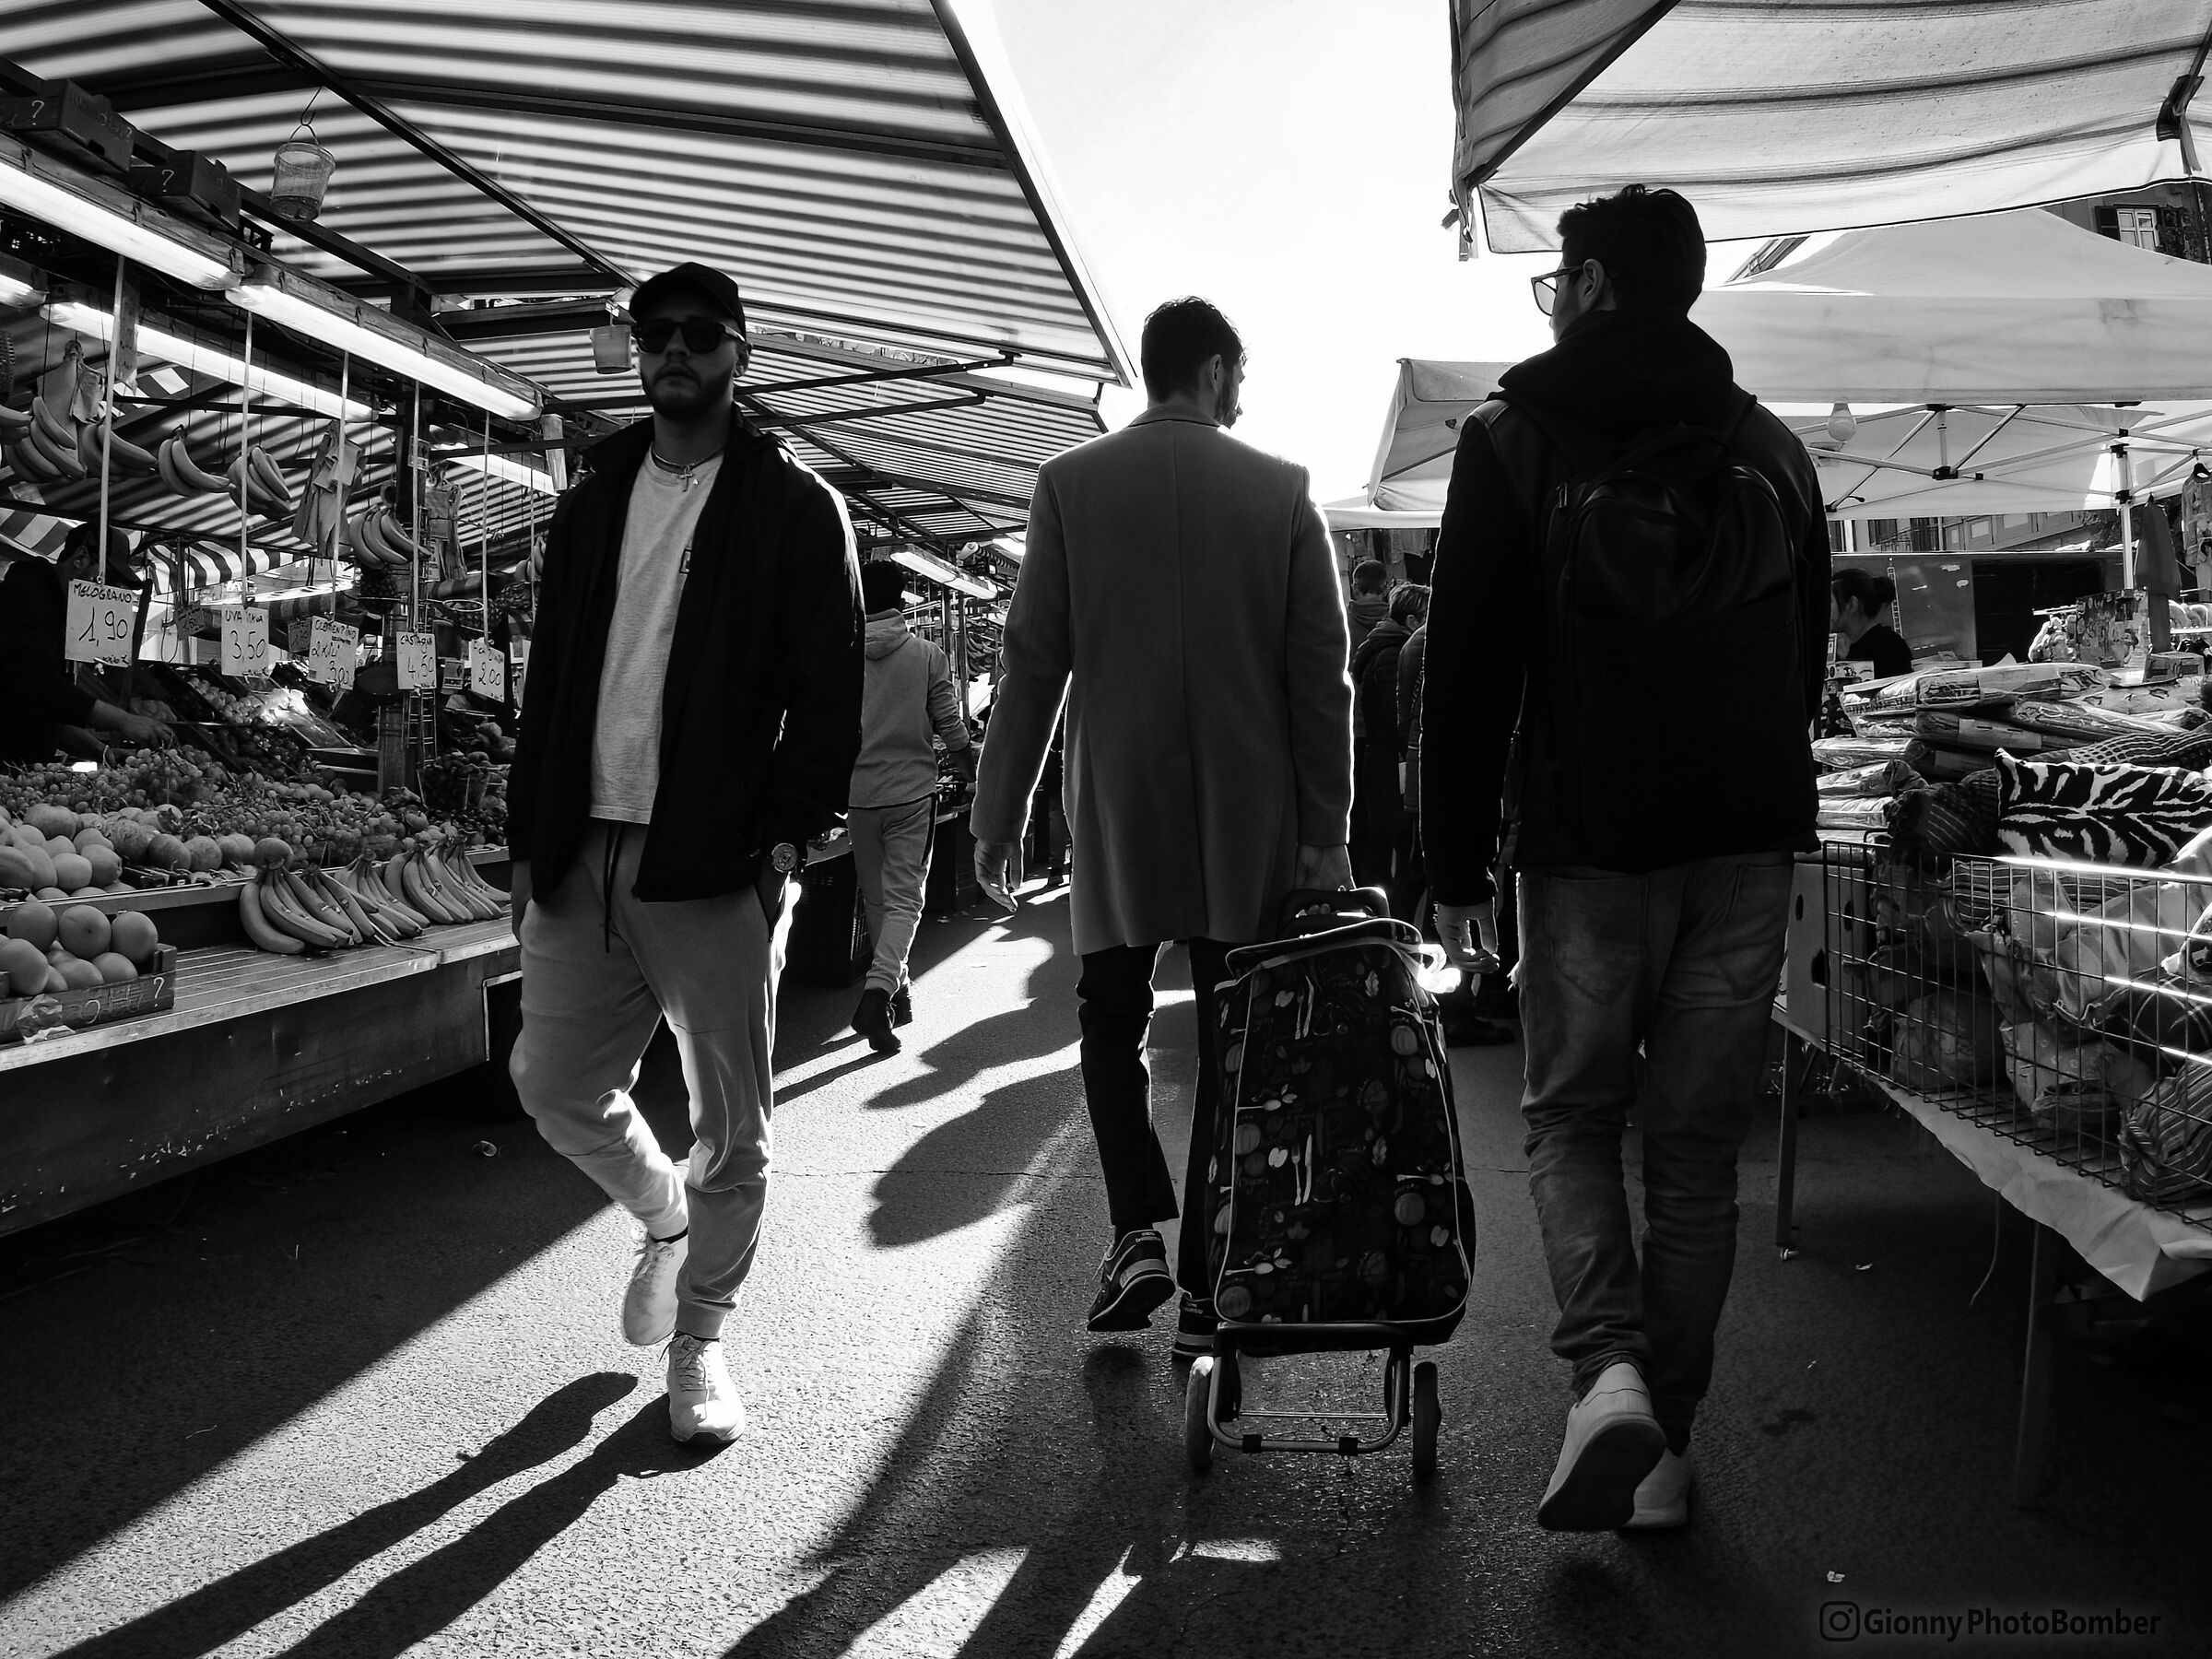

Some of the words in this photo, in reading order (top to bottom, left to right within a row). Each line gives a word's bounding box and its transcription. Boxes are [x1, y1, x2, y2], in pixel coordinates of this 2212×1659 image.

[74, 582, 133, 604] MELOGRANO
[78, 606, 129, 647] 1,90
[230, 629, 265, 663] 3,50
